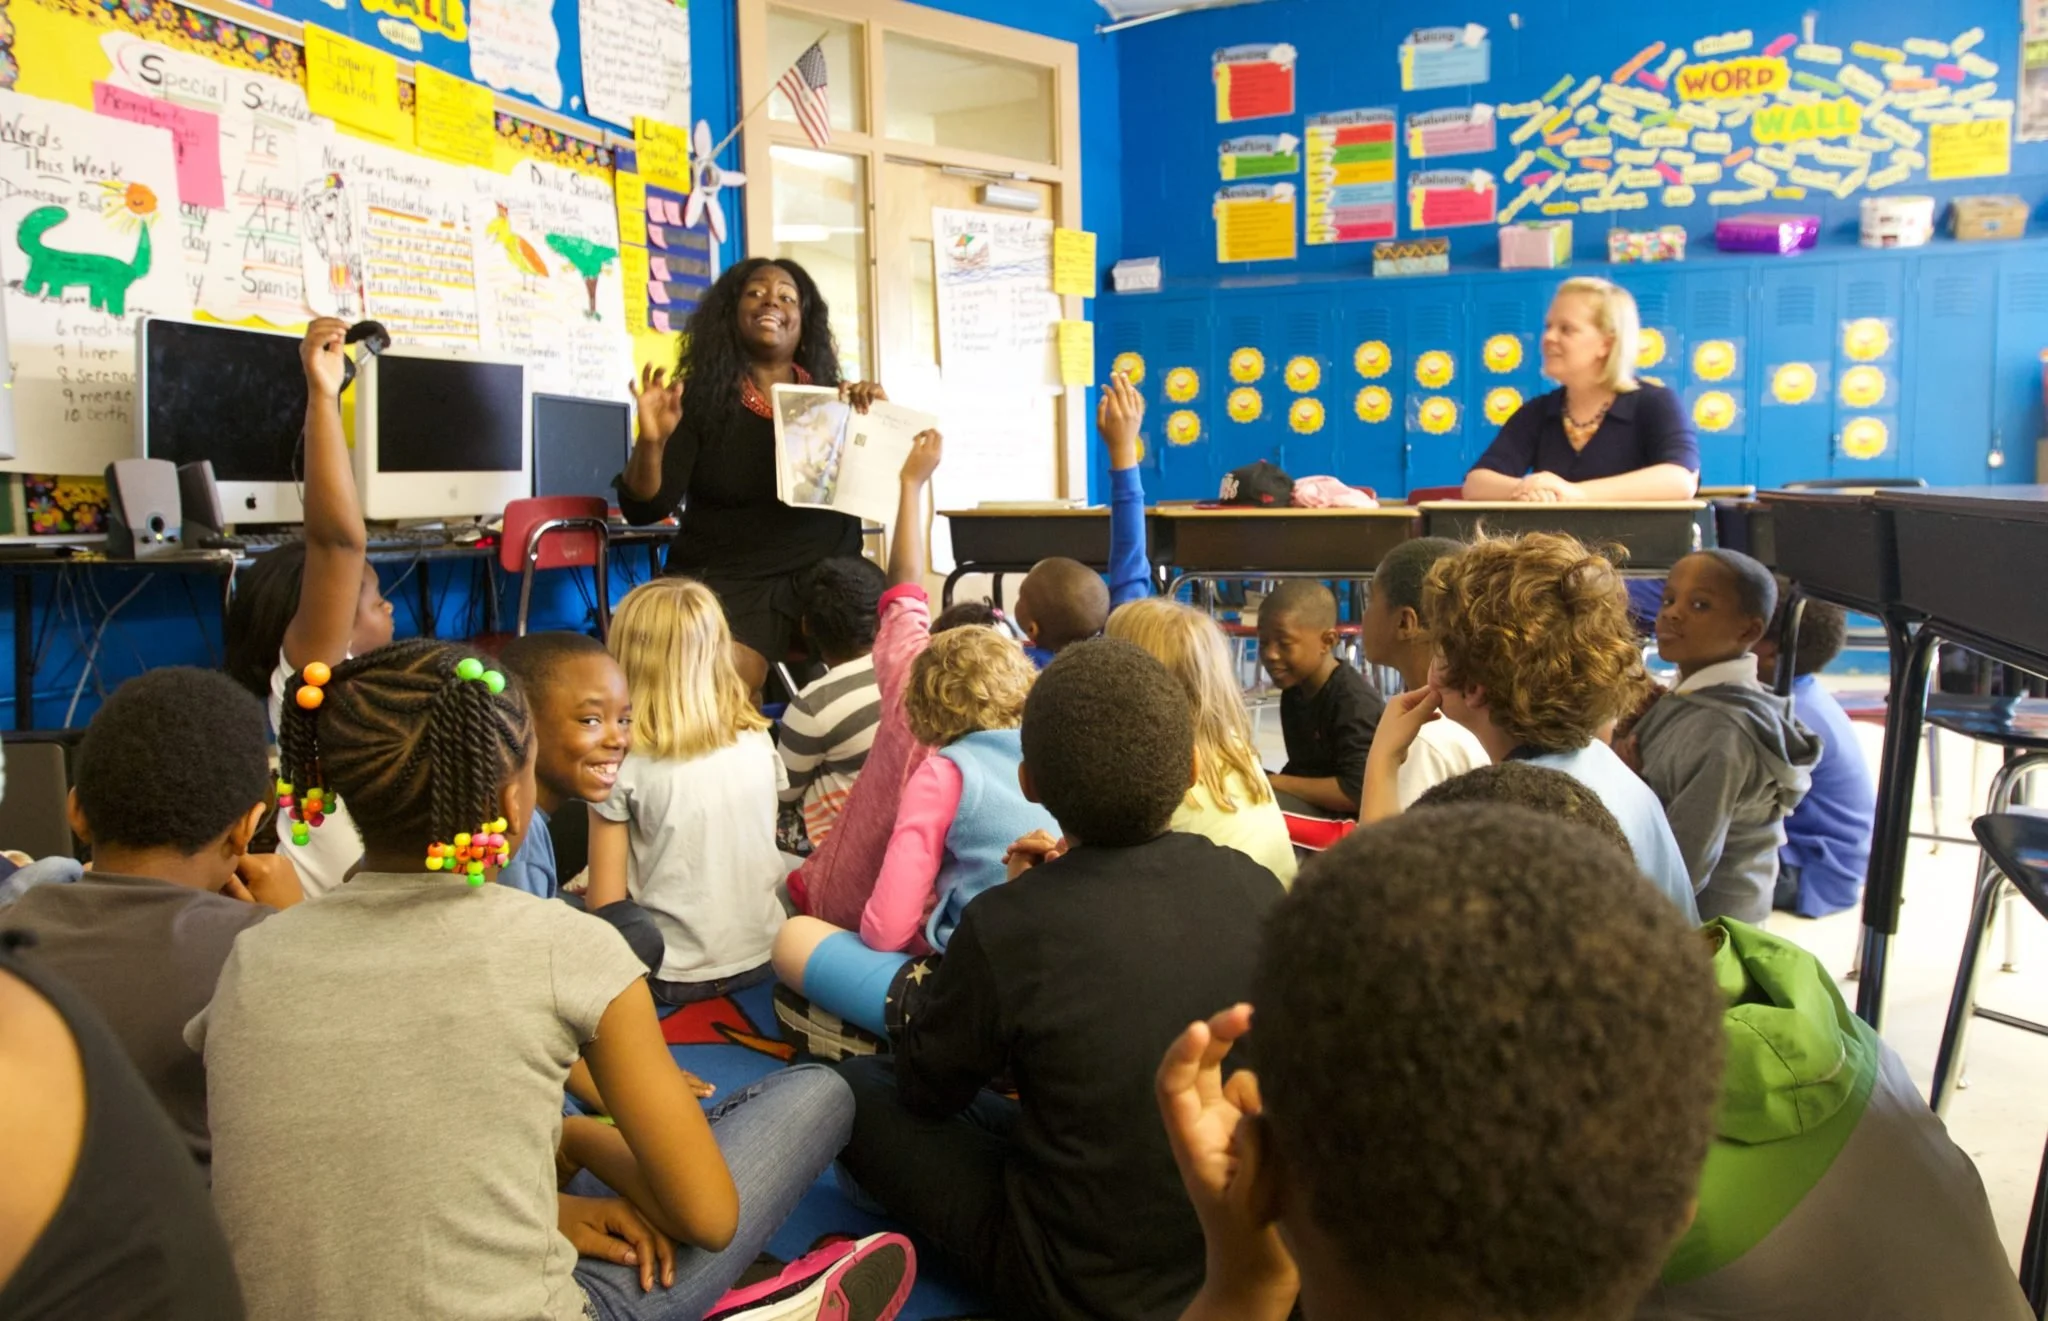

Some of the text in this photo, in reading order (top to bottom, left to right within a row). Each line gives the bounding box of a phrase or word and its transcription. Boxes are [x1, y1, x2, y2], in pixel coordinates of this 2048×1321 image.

[139, 53, 228, 101] Special
[1683, 68, 1774, 94] WORD
[1757, 104, 1856, 136] WALL
